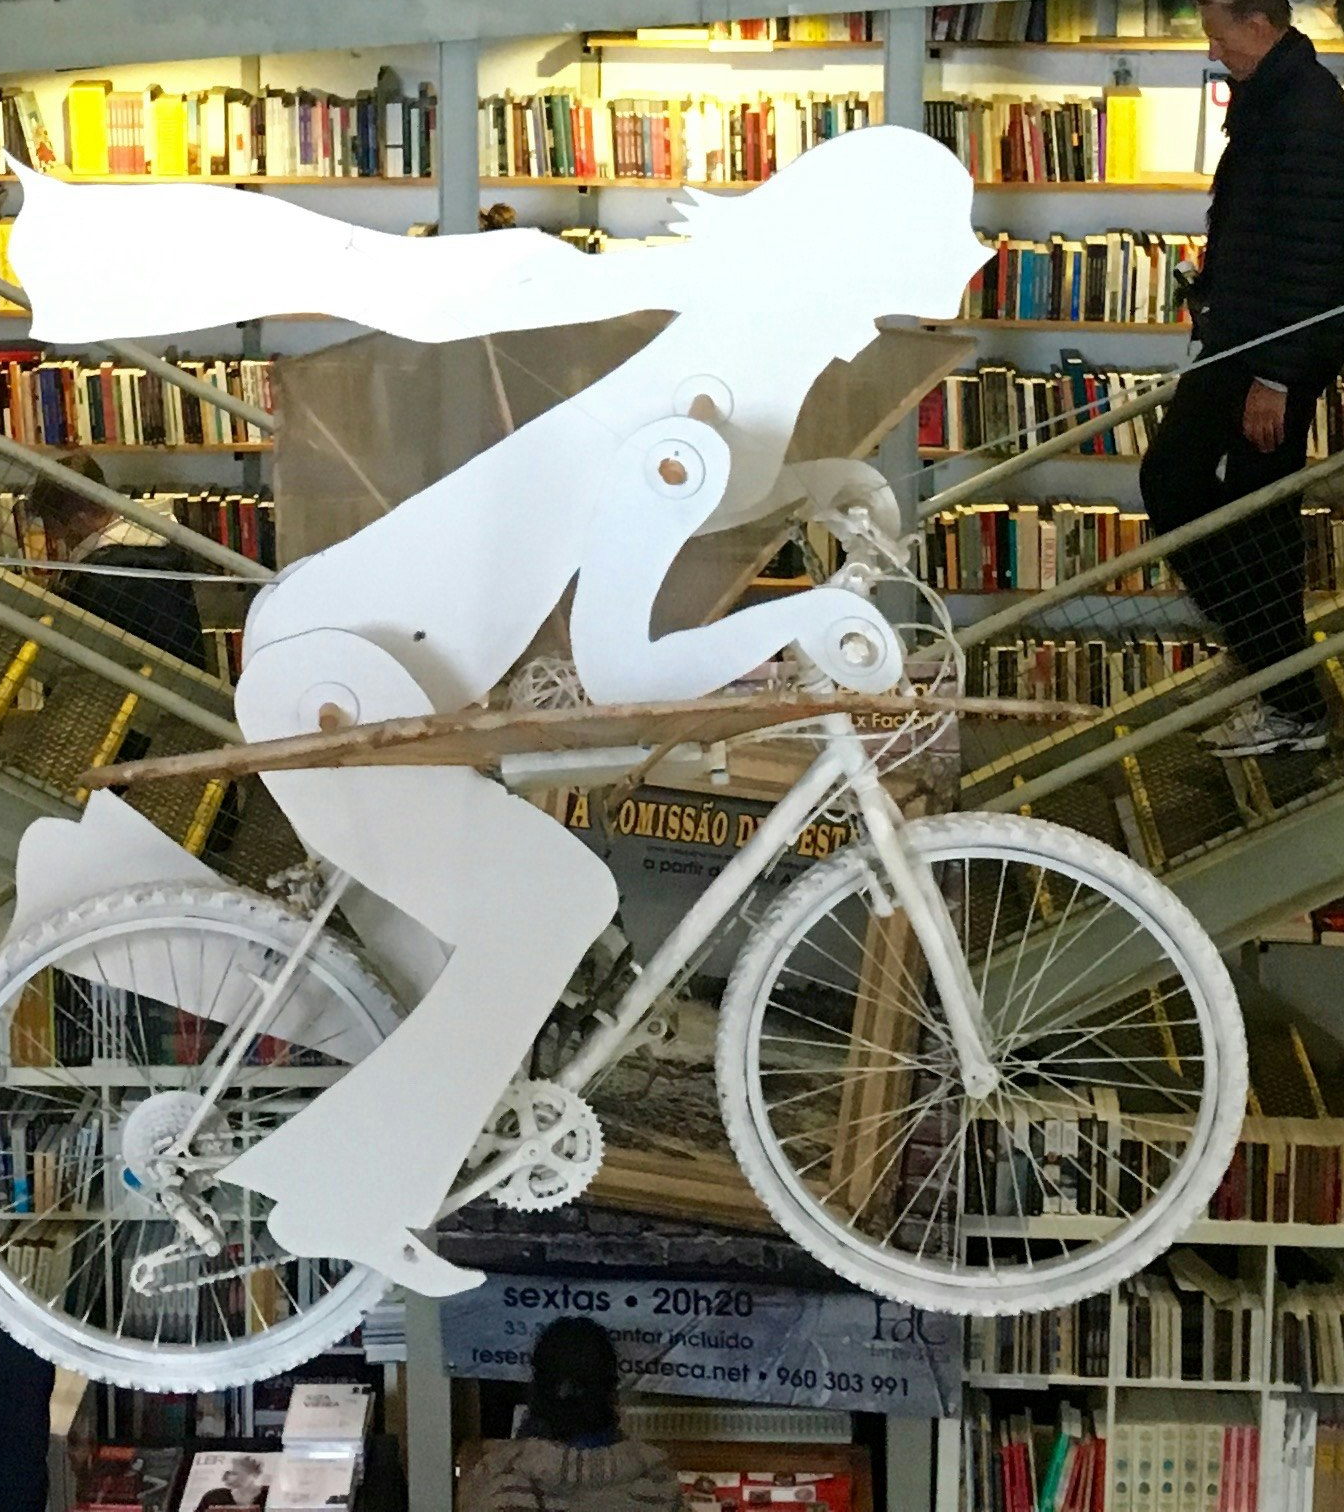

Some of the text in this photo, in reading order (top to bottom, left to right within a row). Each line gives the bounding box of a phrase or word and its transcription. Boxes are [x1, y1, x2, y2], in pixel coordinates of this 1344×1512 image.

[504, 1286, 754, 1317] sextas 20h20
[776, 1367, 817, 1389] 960
[824, 1372, 863, 1394] 303
[871, 1376, 908, 1397] 991
